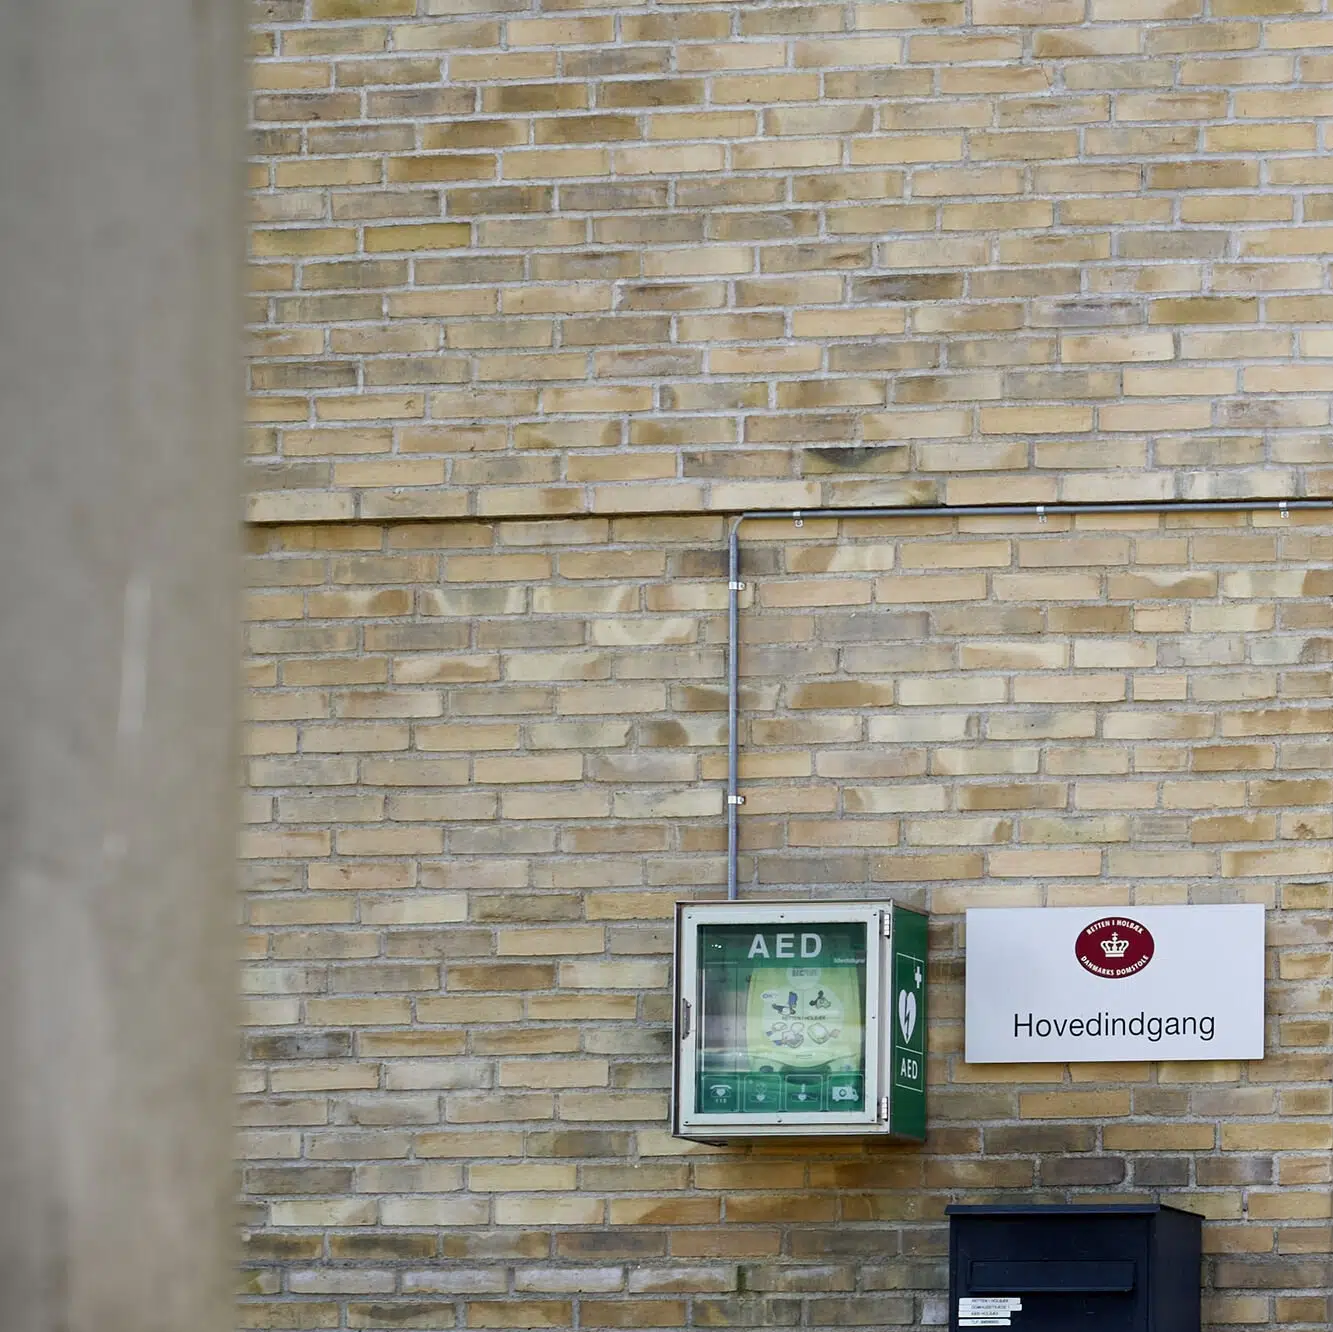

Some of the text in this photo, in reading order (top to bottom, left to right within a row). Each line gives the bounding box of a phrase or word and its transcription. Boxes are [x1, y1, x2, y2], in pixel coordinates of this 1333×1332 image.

[1086, 920, 1110, 935] RETTEN
[747, 933, 822, 959] AED
[1081, 954, 1149, 976] DANMARKS DOMSTOLE
[1014, 1011, 1215, 1042] Hovedindgang
[900, 1057, 918, 1080] AED
